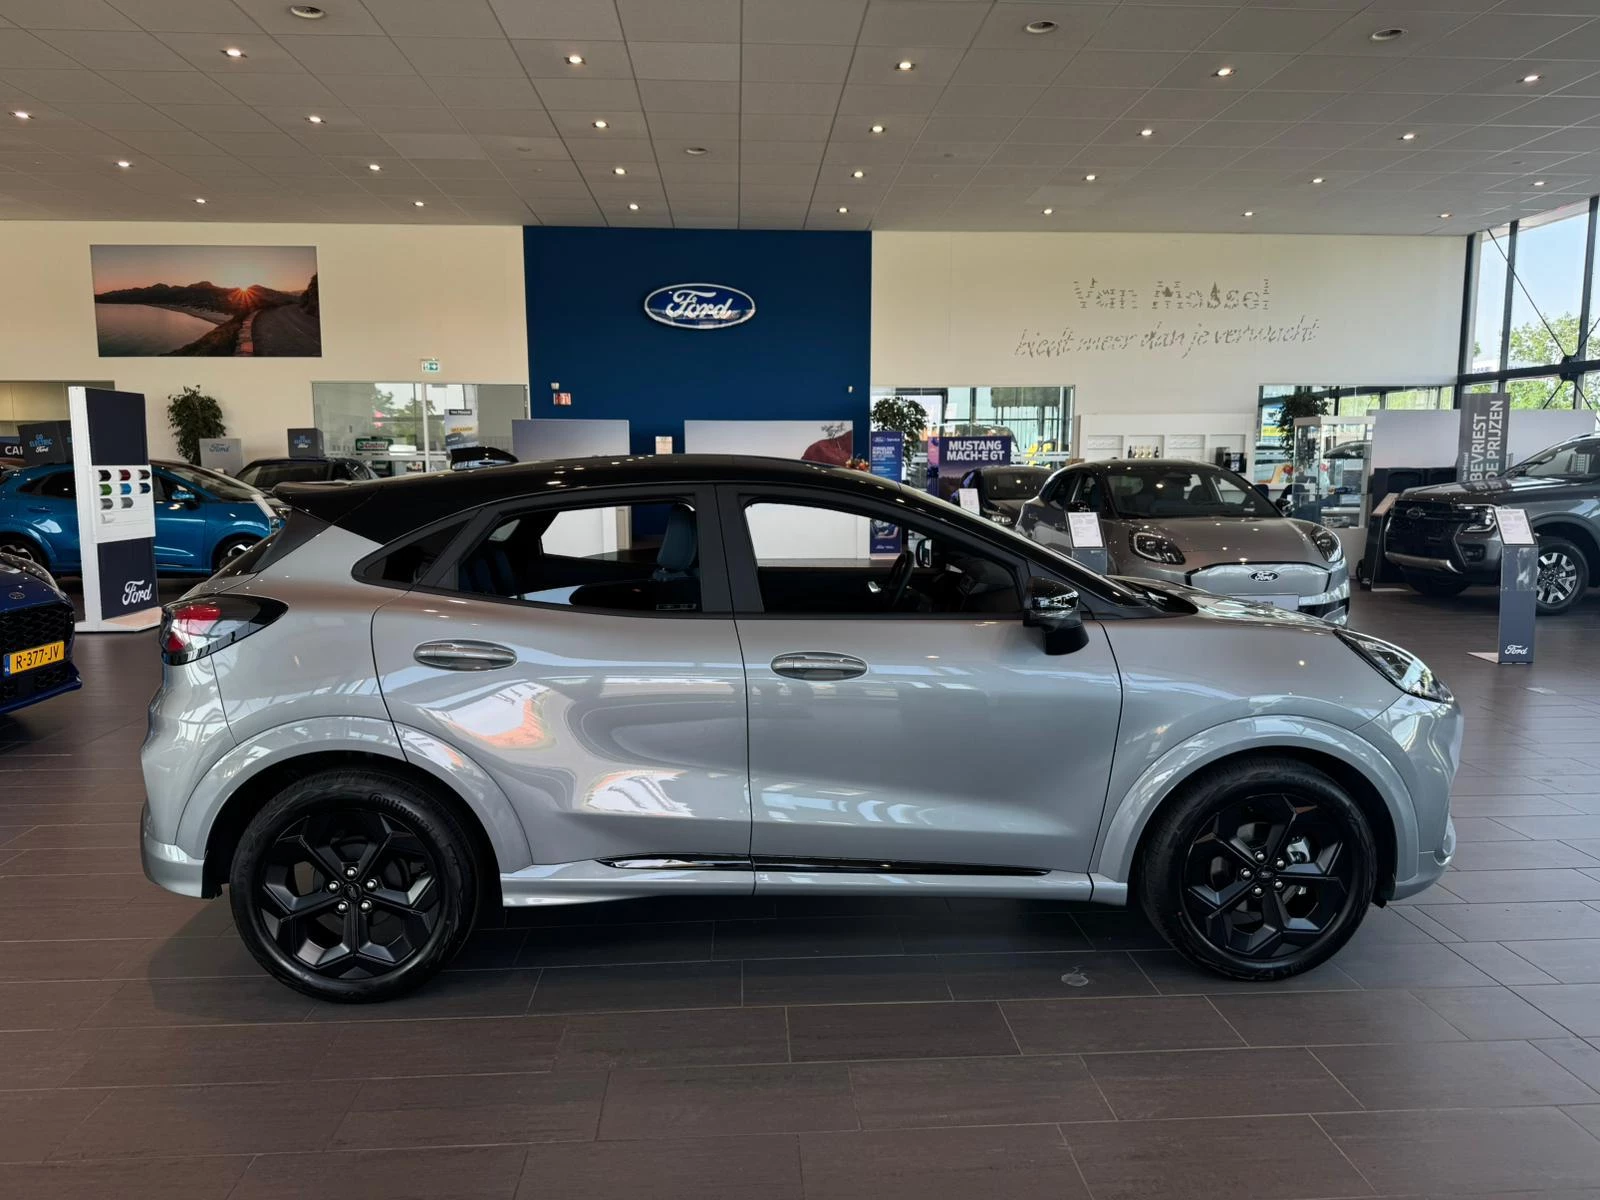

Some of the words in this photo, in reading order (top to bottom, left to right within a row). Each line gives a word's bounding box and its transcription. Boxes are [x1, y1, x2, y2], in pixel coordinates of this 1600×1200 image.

[666, 290, 733, 319] Ford
[1073, 277, 1138, 310] Van
[1151, 278, 1270, 310] Mossel
[1014, 327, 1074, 358] biedt
[1076, 332, 1138, 352] meer
[1140, 321, 1186, 350] dan
[1182, 323, 1211, 359] je
[1214, 315, 1321, 345] verwacht
[1486, 400, 1504, 459] PRIJZEN
[946, 451, 989, 461] MACH-E
[990, 451, 1006, 460] GT
[948, 440, 1002, 451] MUSTANG
[1469, 413, 1487, 481] BEVRIEST
[122, 579, 152, 606] Ford
[16, 644, 60, 669] R-377-JV
[1504, 644, 1529, 655] Ford
[368, 791, 435, 833] Continental
